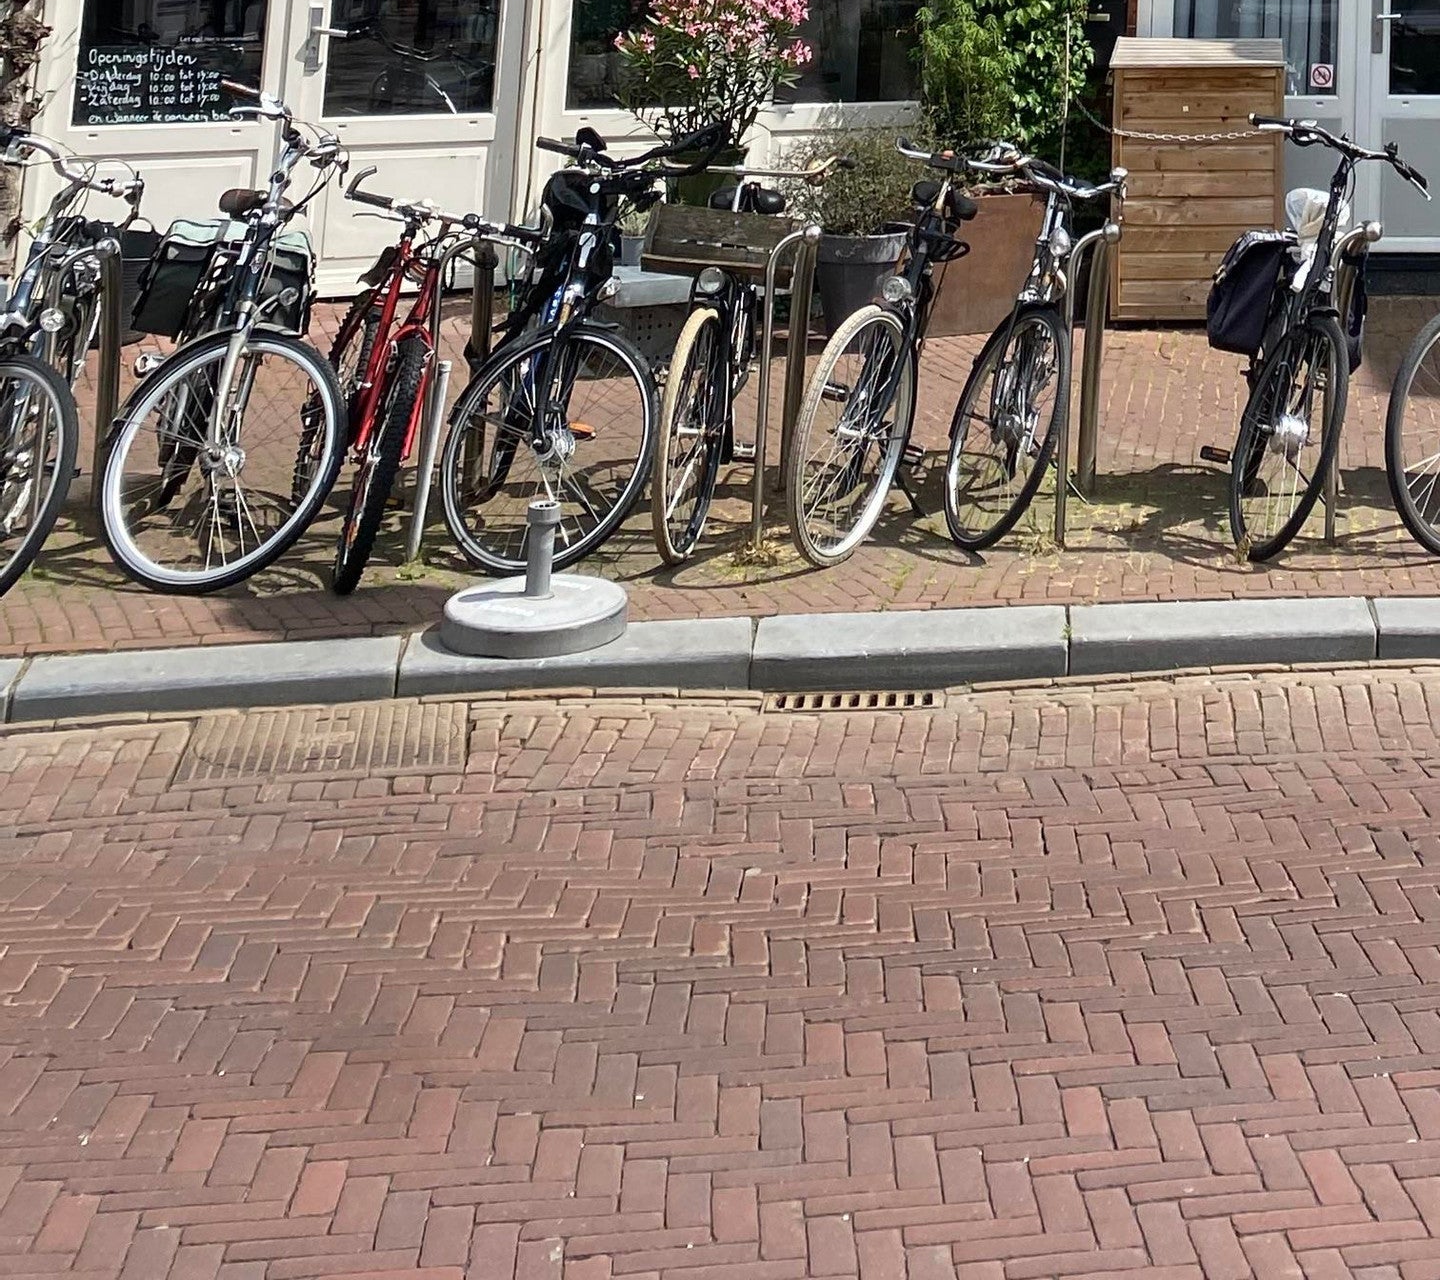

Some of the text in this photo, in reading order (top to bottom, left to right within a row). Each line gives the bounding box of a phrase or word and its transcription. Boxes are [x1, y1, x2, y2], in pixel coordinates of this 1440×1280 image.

[89, 48, 198, 71] Openingstijden
[179, 69, 194, 80] tot
[180, 81, 195, 91] tot
[180, 92, 194, 104] tot
